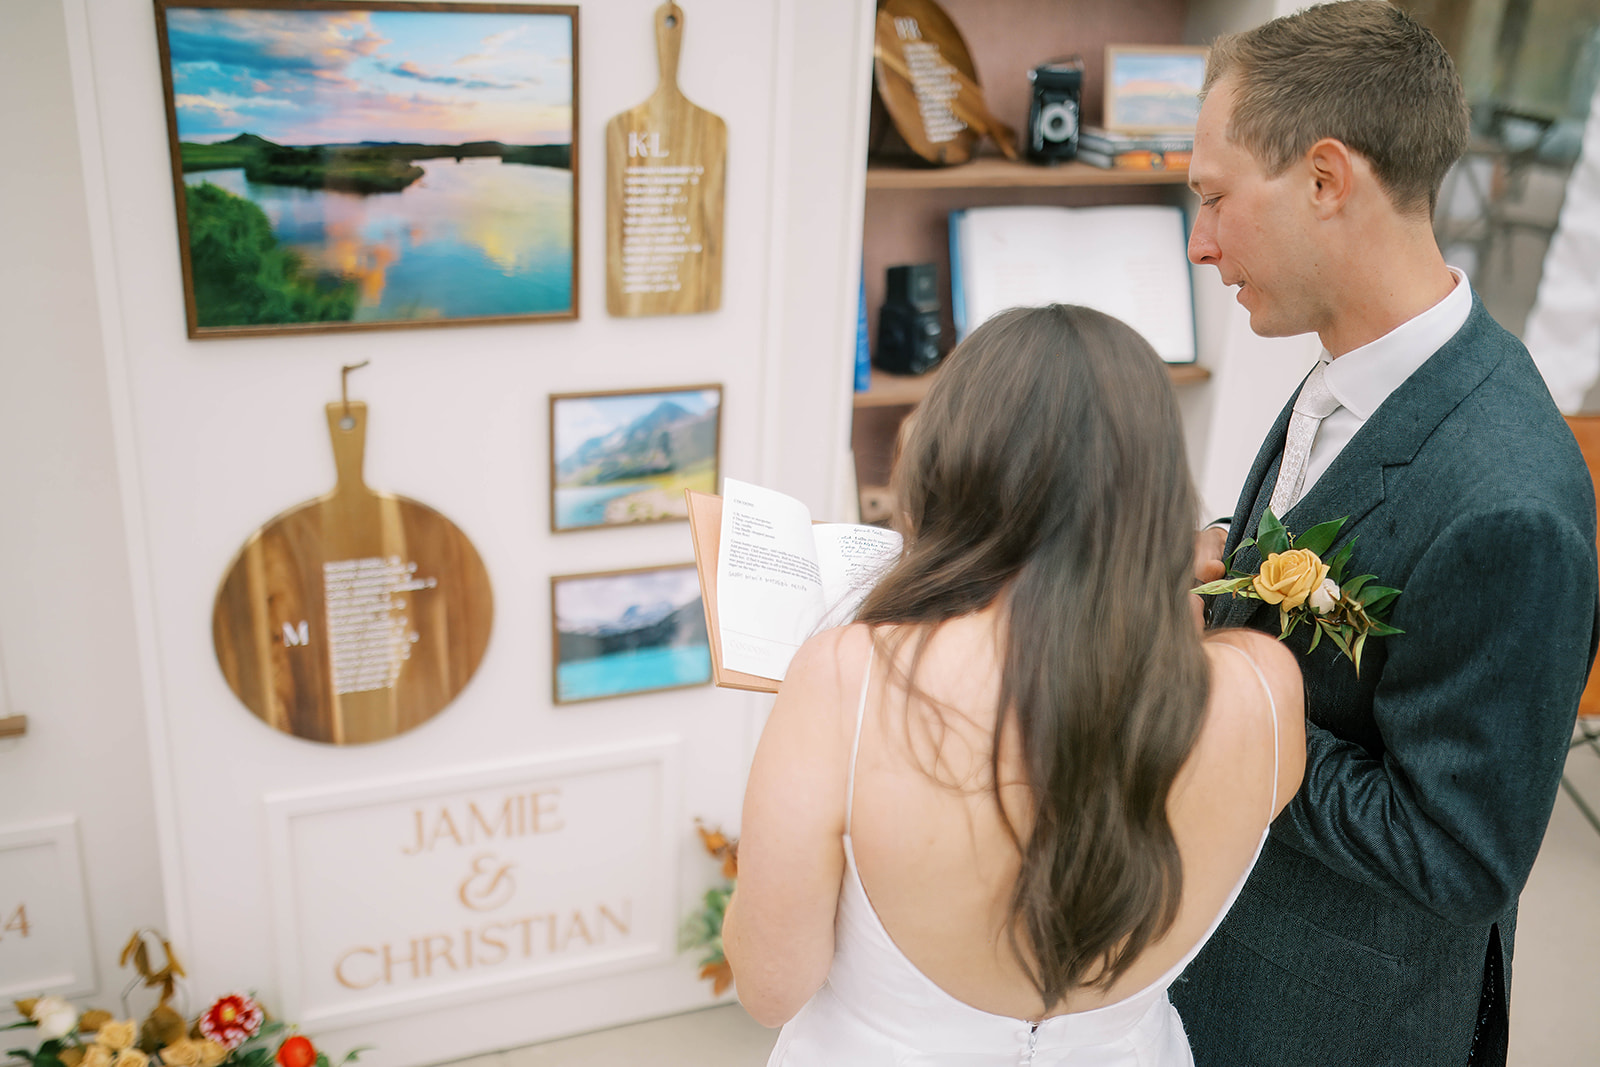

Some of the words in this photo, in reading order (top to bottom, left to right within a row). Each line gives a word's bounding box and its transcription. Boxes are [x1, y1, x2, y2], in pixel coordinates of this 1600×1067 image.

[283, 620, 309, 647] M
[401, 787, 567, 857] JAMIE
[459, 851, 518, 913] &
[334, 899, 632, 990] CHRISTIAN
